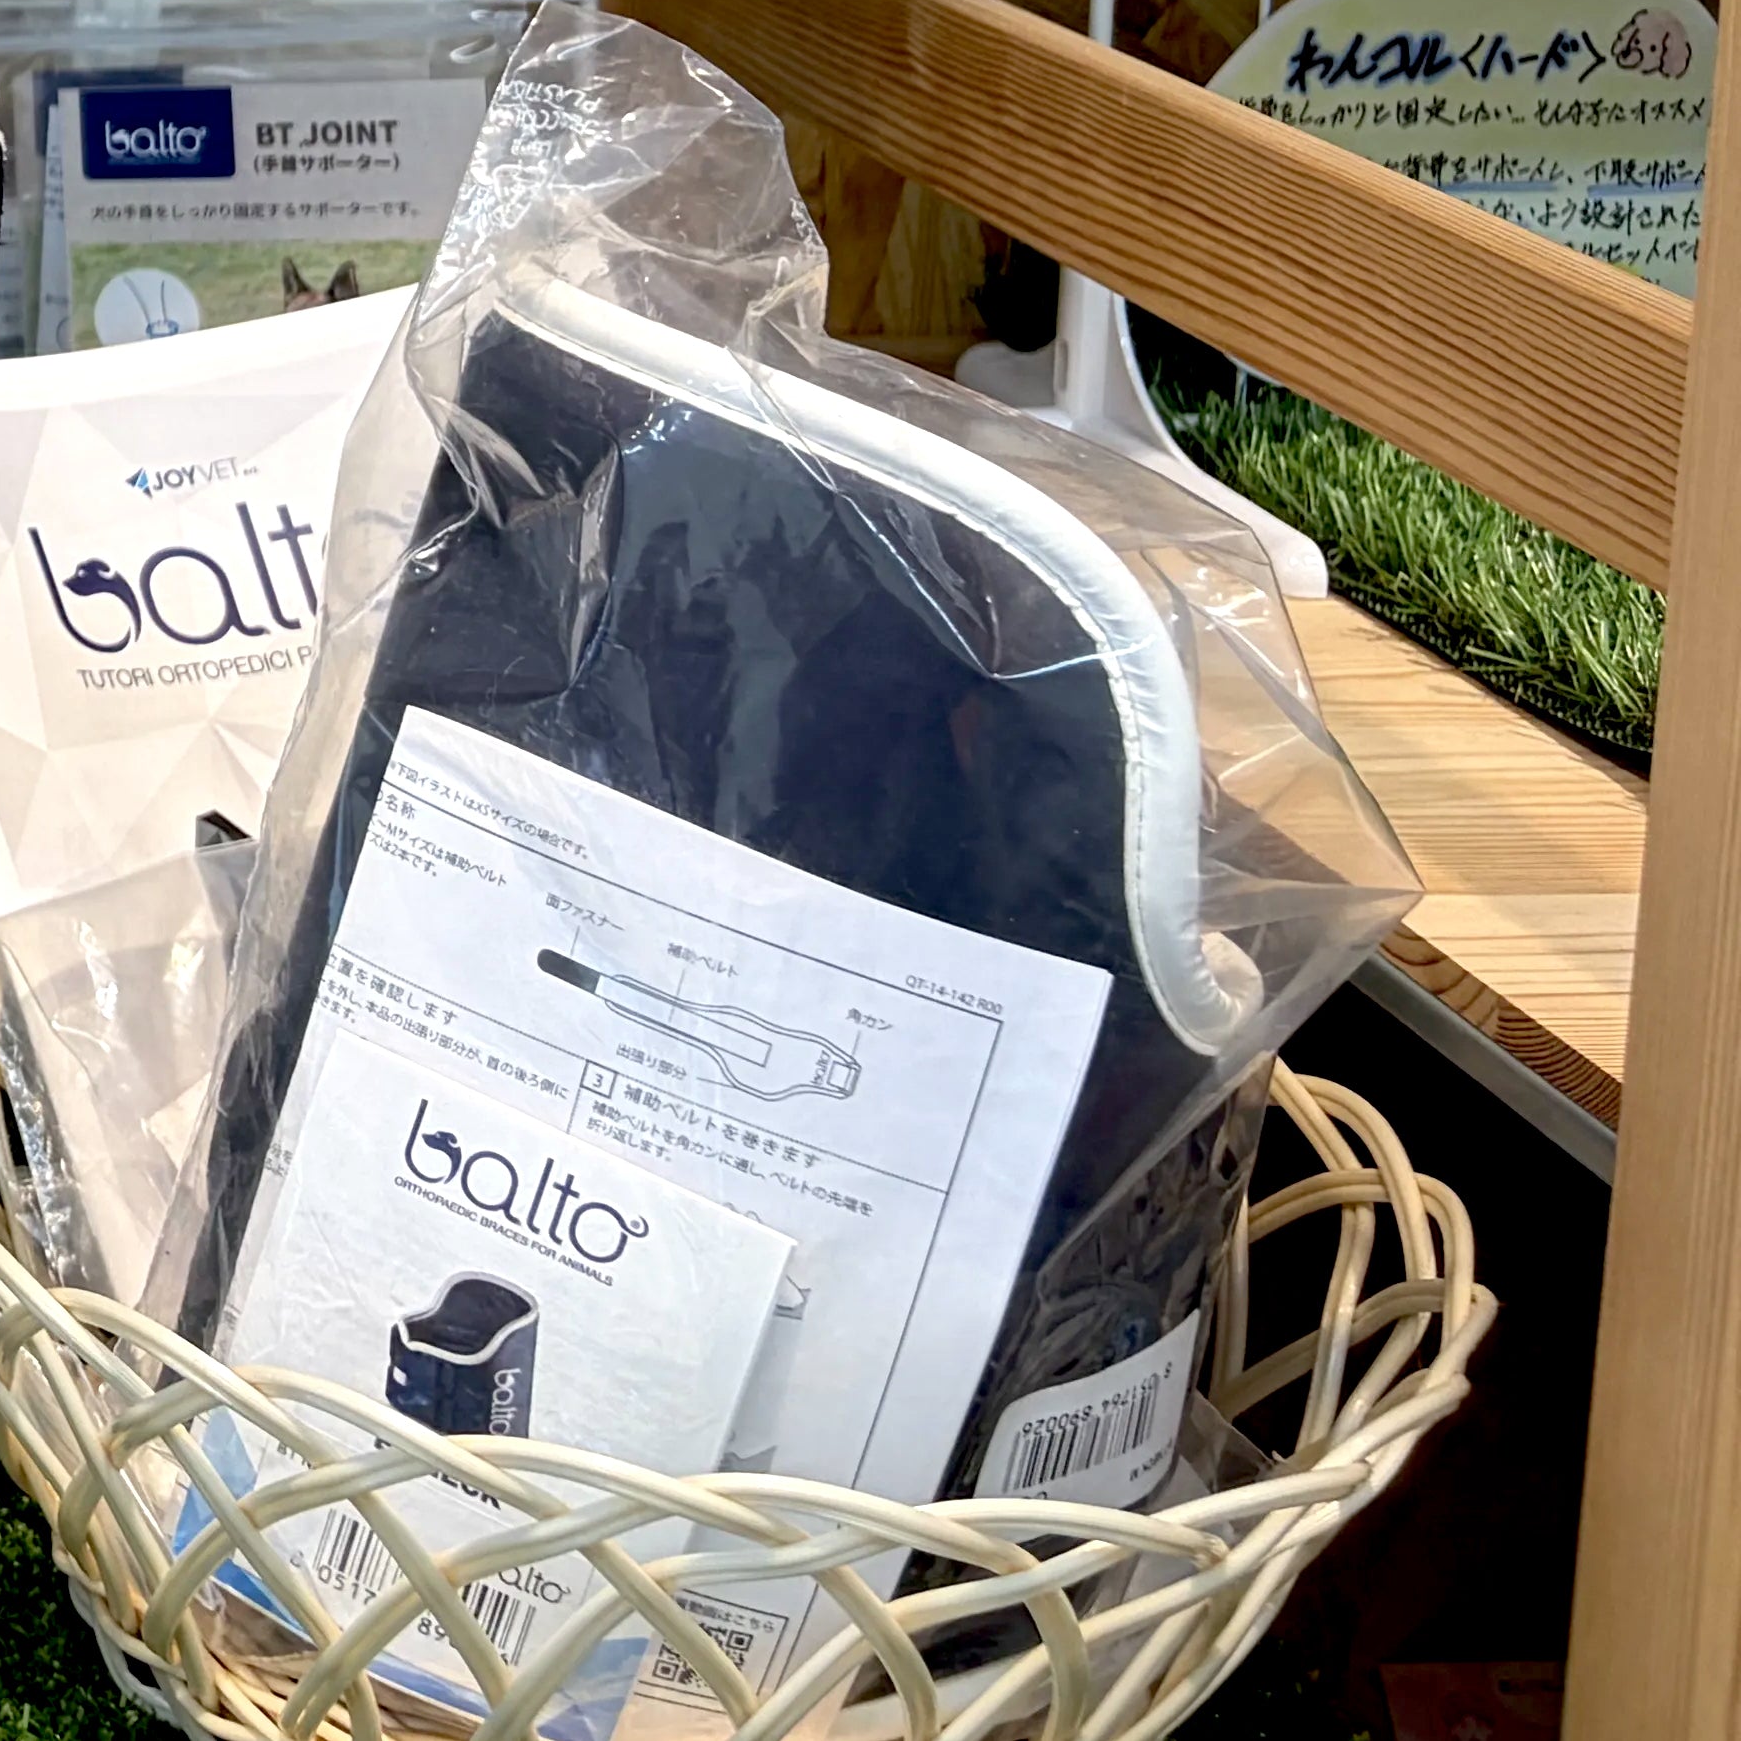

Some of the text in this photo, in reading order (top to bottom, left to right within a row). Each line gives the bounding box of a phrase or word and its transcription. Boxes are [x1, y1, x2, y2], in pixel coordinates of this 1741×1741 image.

[104, 117, 208, 158] balto
[255, 118, 400, 148] BT JOINT
[152, 457, 239, 492] JOYVET
[27, 501, 319, 654] balt
[76, 651, 296, 690] TUTORI ORTOPEDICI
[545, 892, 626, 932] 面ファスナー
[667, 942, 740, 979] 補助ベルト
[319, 977, 570, 1102] を外し、本品の出張り部分が、首の後ろ側に
[846, 1007, 894, 1032] 角カン
[622, 1083, 821, 1170] 補助ベルトを巻きます
[403, 1097, 651, 1265] balto
[393, 1174, 614, 1288] ORTHOPAEDIC BRACES FOR ANIMALS
[488, 1366, 523, 1437] balto
